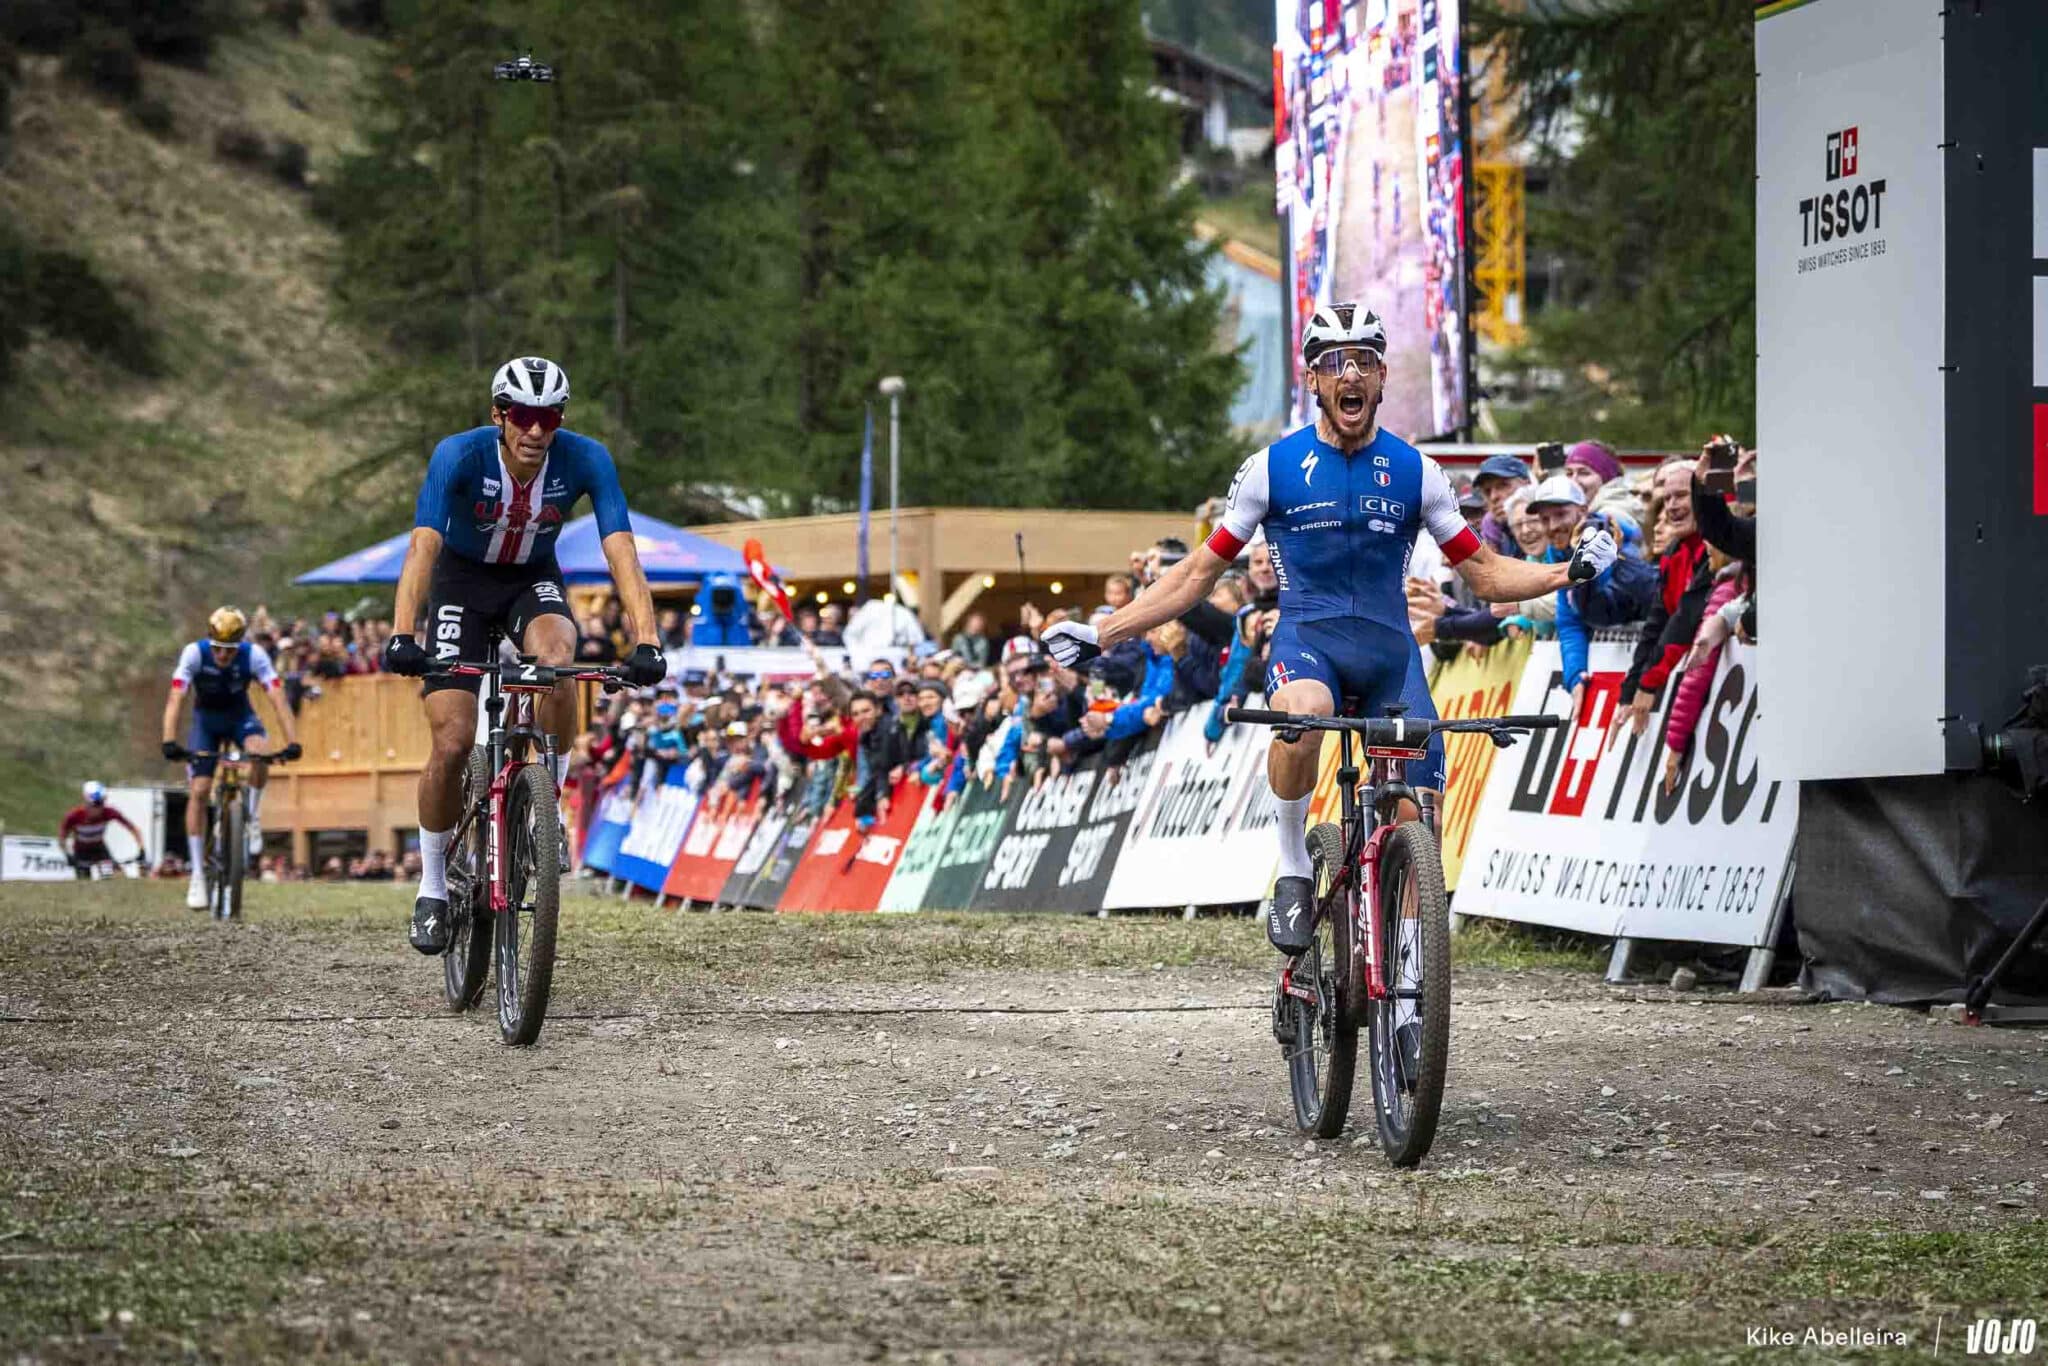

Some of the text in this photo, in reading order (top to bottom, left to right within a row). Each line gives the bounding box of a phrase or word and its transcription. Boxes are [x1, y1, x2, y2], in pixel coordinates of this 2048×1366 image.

[1799, 179, 1886, 247] TISSOT
[1797, 256, 1817, 274] SWISS
[1818, 248, 1848, 269] WATCHES
[1849, 243, 1869, 262] SINCE
[1286, 501, 1338, 515] LOOK
[1365, 499, 1401, 516] CIC
[1300, 520, 1342, 531] FACOM
[1269, 542, 1290, 591] FRANCE
[436, 604, 464, 660] USA
[519, 664, 537, 680] 2
[1392, 718, 1404, 741] 1
[1482, 848, 1765, 914] SWISS WATCHES SINCE 1853
